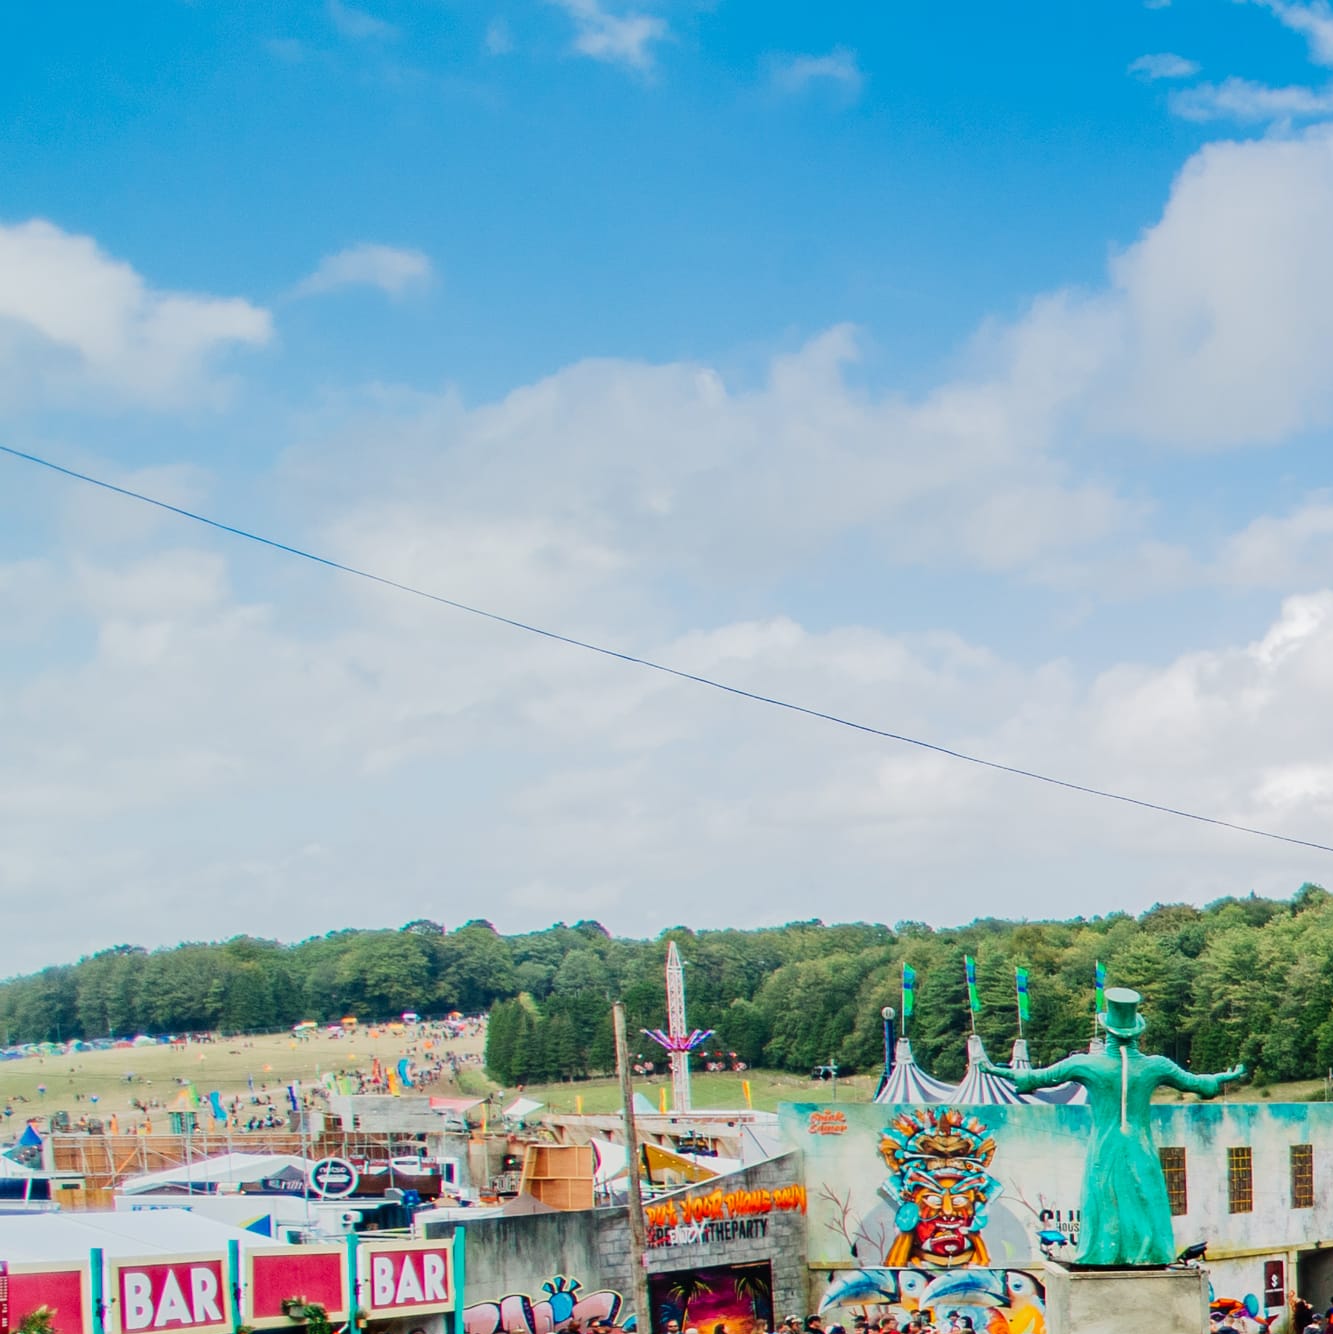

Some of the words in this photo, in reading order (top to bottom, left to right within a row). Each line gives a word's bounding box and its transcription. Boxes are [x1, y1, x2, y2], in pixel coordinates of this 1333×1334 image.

[645, 1198, 679, 1227] PUT
[680, 1187, 724, 1224] YOUR
[724, 1188, 772, 1217] PHONE
[773, 1183, 807, 1216] DOWN
[124, 1267, 222, 1330] BAR
[374, 1254, 447, 1305] BAR
